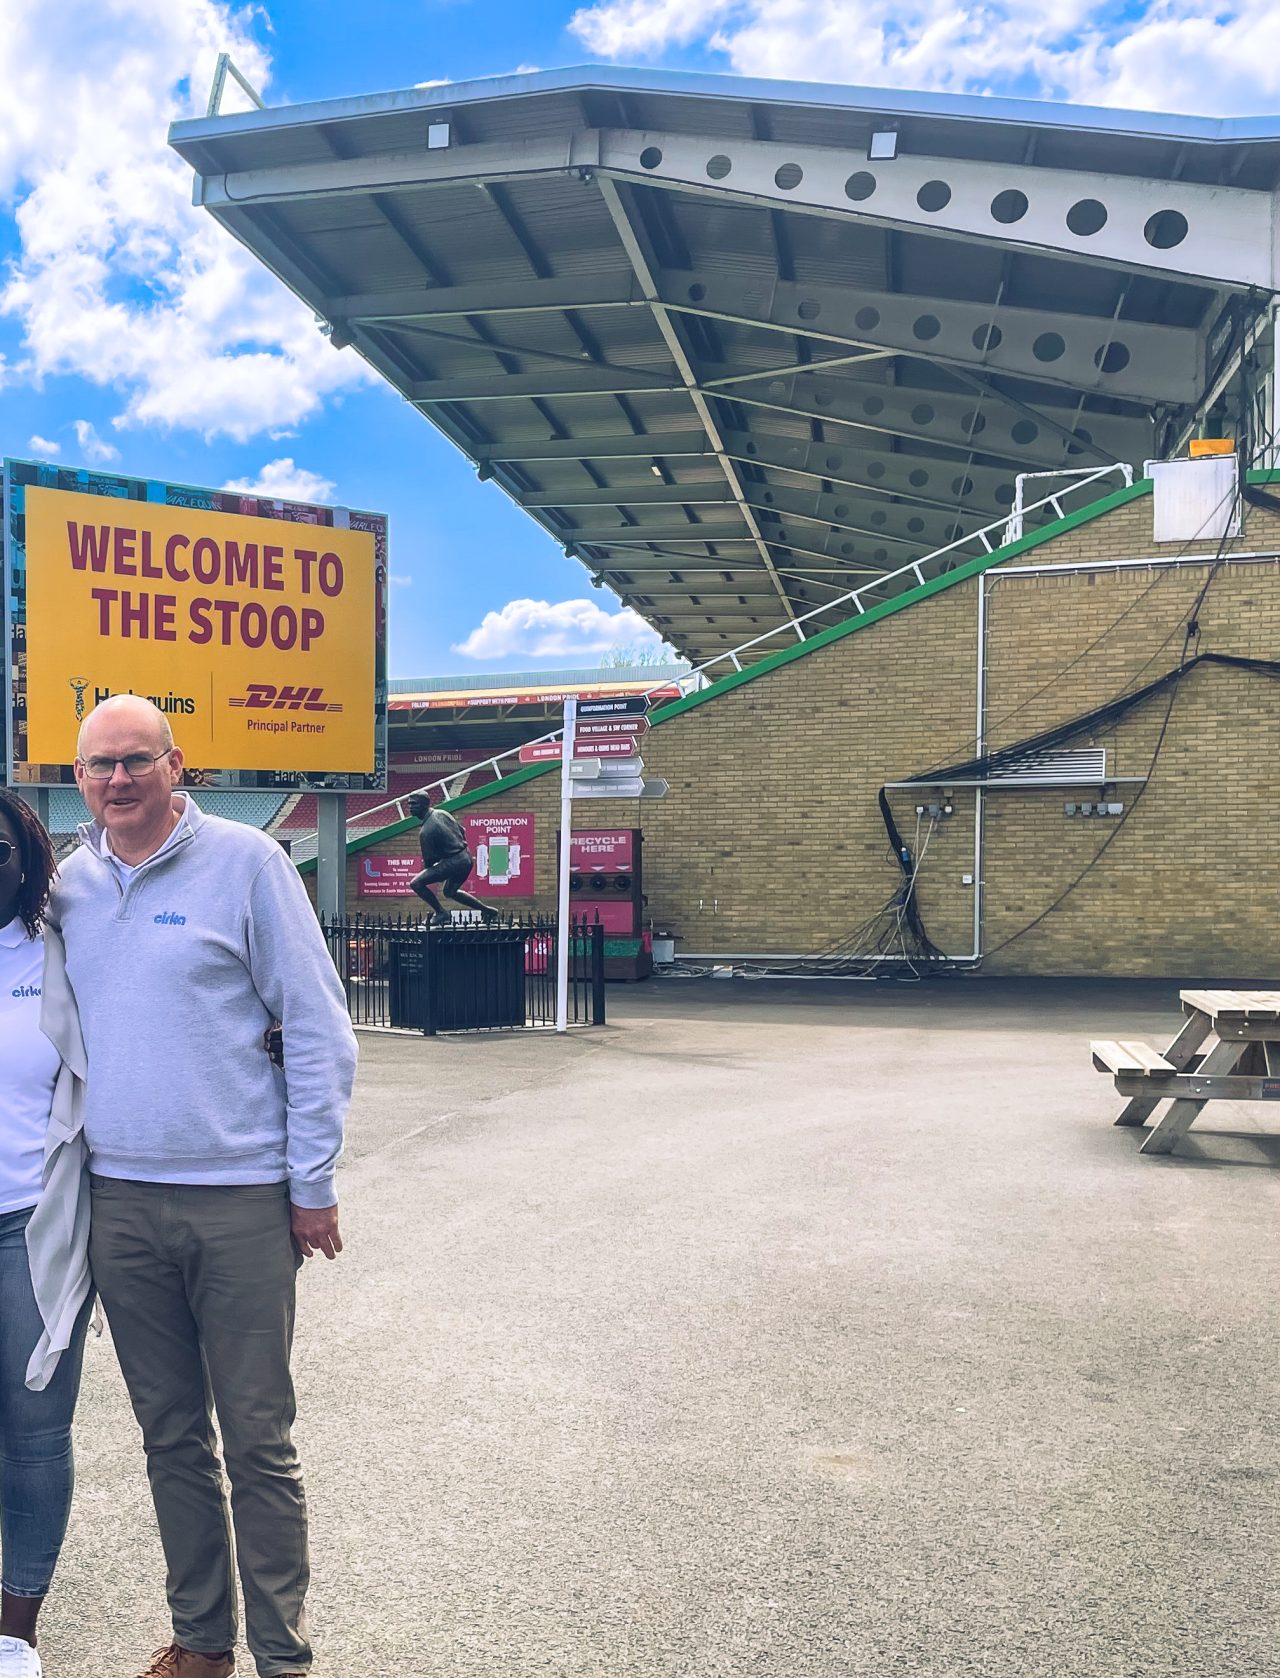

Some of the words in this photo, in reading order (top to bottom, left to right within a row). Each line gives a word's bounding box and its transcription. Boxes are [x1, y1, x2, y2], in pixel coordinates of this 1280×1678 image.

[67, 521, 284, 591] WELCOME
[294, 549, 344, 597] TO
[91, 588, 177, 641] THE
[188, 597, 325, 651] STOOP
[95, 688, 195, 714] Huins
[245, 684, 329, 712] DHL
[537, 694, 562, 702] LONDON
[247, 719, 288, 734] Principal
[291, 721, 326, 733] Partner
[621, 723, 638, 731] CORNER
[443, 754, 462, 762] PRIDE
[470, 818, 528, 826] INFORMATION
[486, 826, 511, 834] POINT
[570, 836, 626, 845] RECYCLE
[581, 845, 615, 853] HERE
